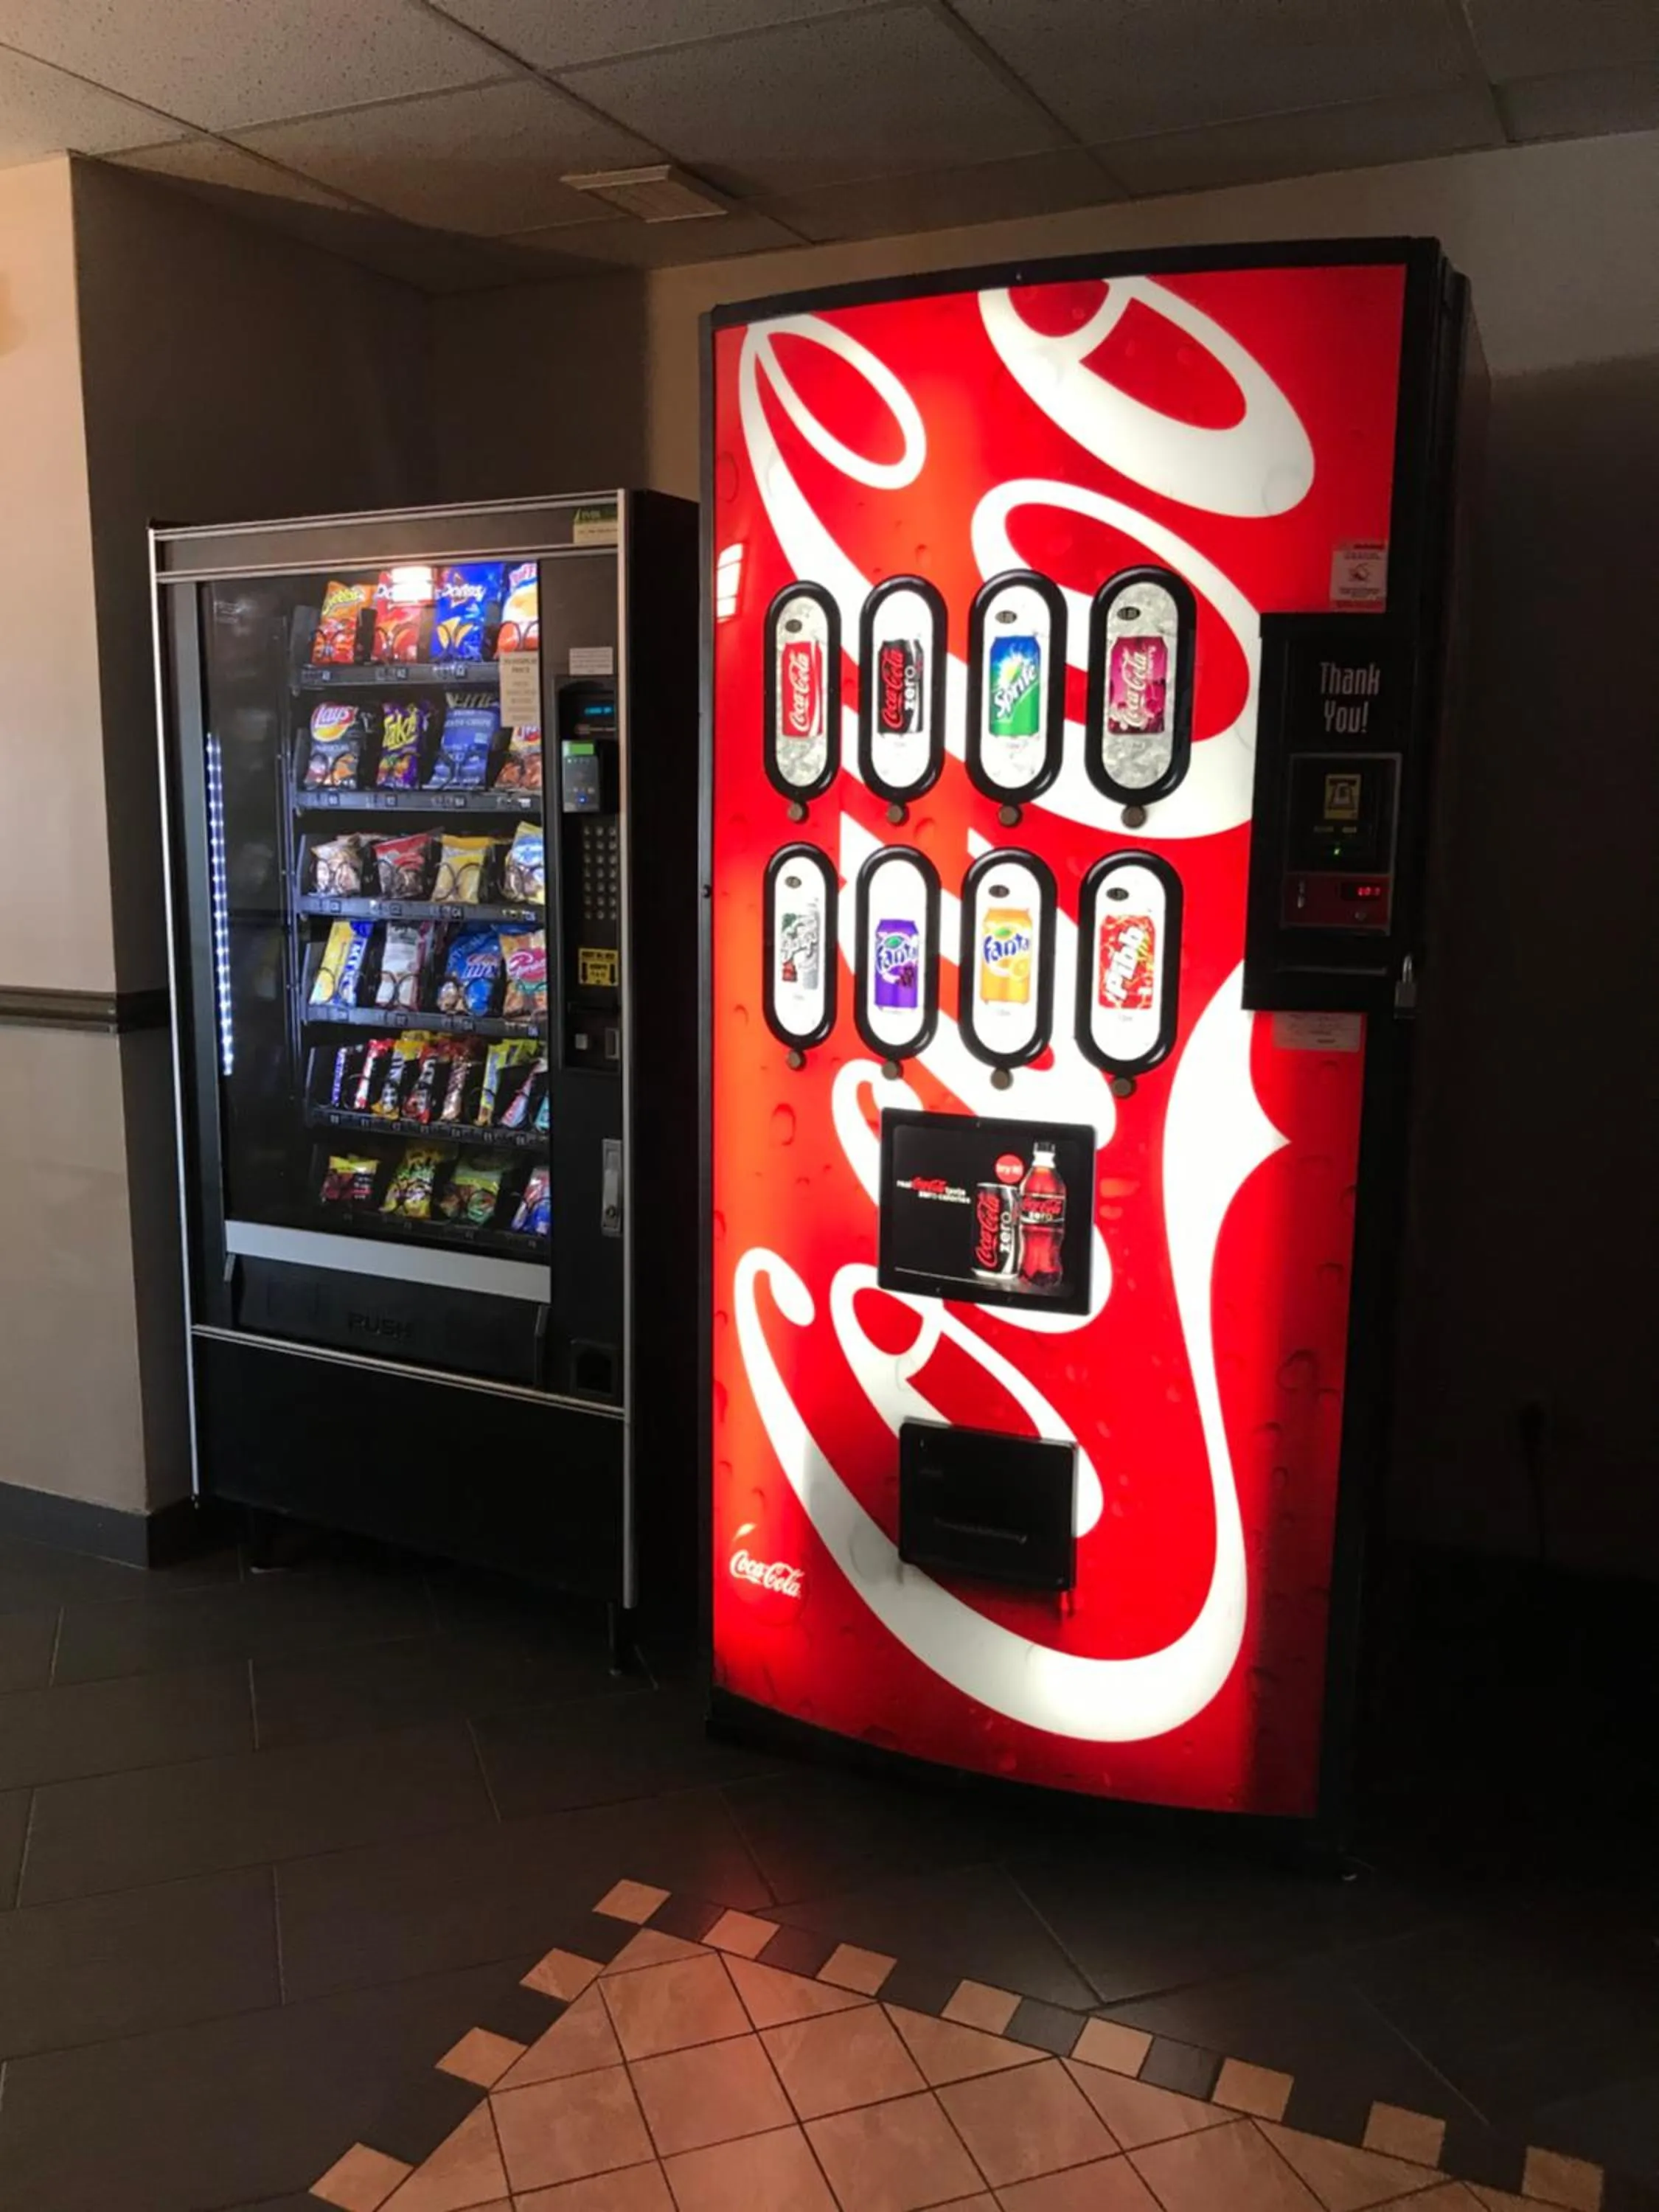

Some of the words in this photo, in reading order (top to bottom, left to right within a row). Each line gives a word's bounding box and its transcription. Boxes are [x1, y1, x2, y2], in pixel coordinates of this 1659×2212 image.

[789, 648, 810, 732] Coca-Cola
[882, 647, 904, 728] Coca-Cola
[905, 665, 916, 711] zero
[994, 662, 1037, 720] Sprite
[1319, 661, 1381, 695] Thank
[1324, 699, 1369, 734] You!
[976, 1190, 1000, 1268] Coca-Cola
[999, 1211, 1012, 1253] zero
[729, 1548, 805, 1599] Coca-Cola
